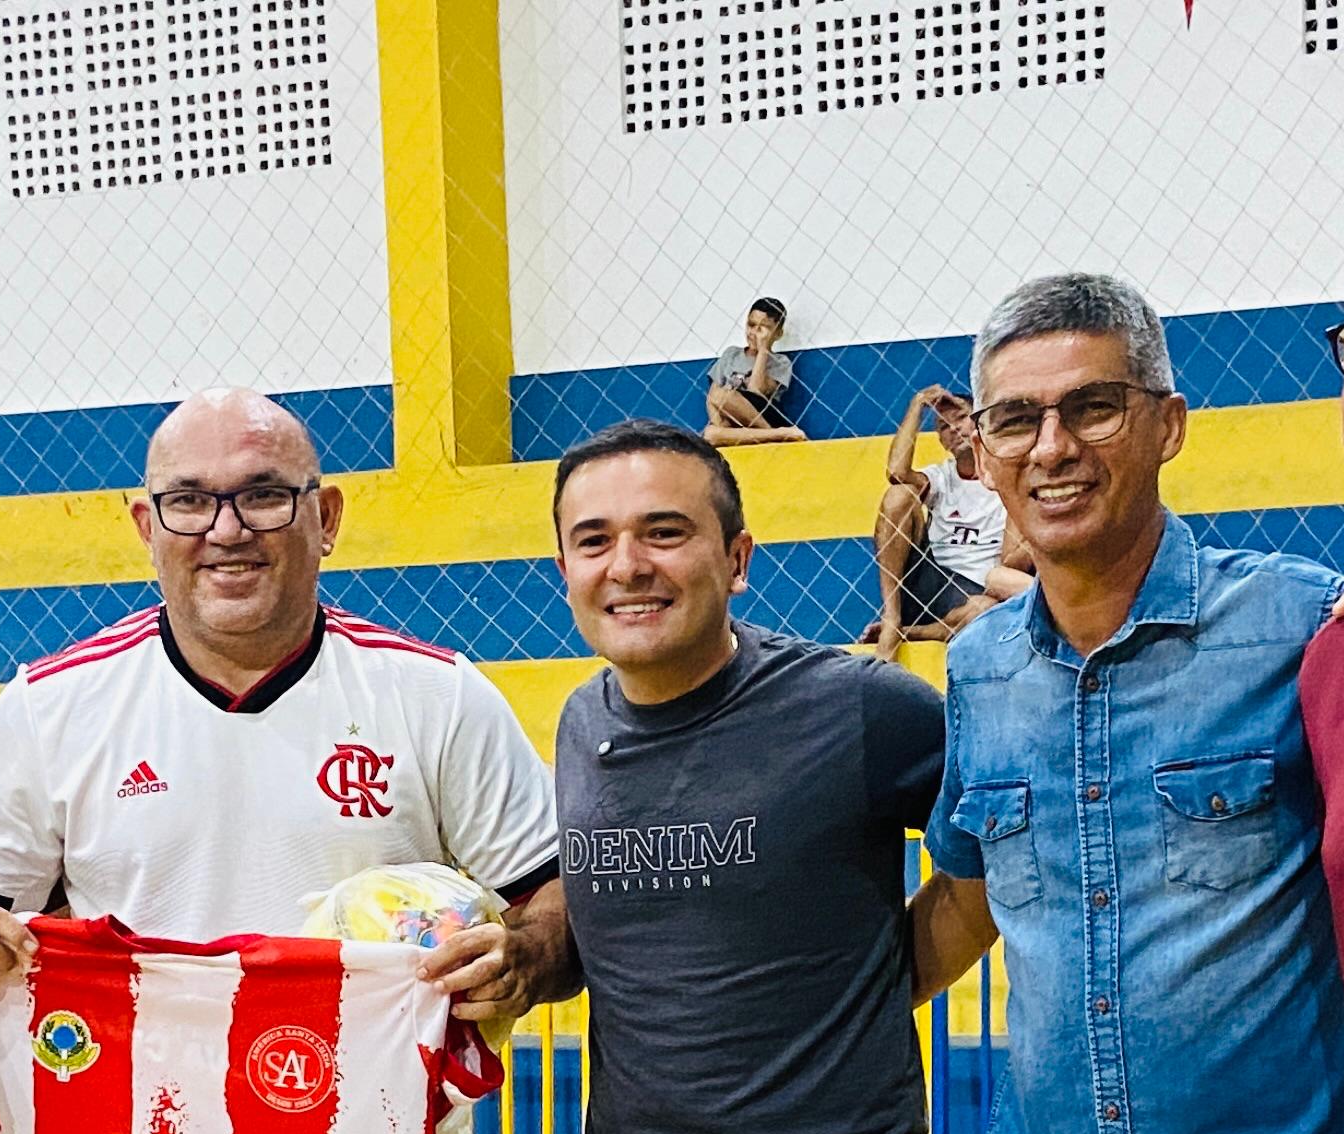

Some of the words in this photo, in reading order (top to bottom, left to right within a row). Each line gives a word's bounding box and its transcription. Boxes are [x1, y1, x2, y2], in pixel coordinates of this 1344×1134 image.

[117, 781, 168, 798] adidas
[566, 816, 756, 874] DENIM
[591, 874, 711, 894] DIVISION
[263, 1049, 317, 1090] SAL
